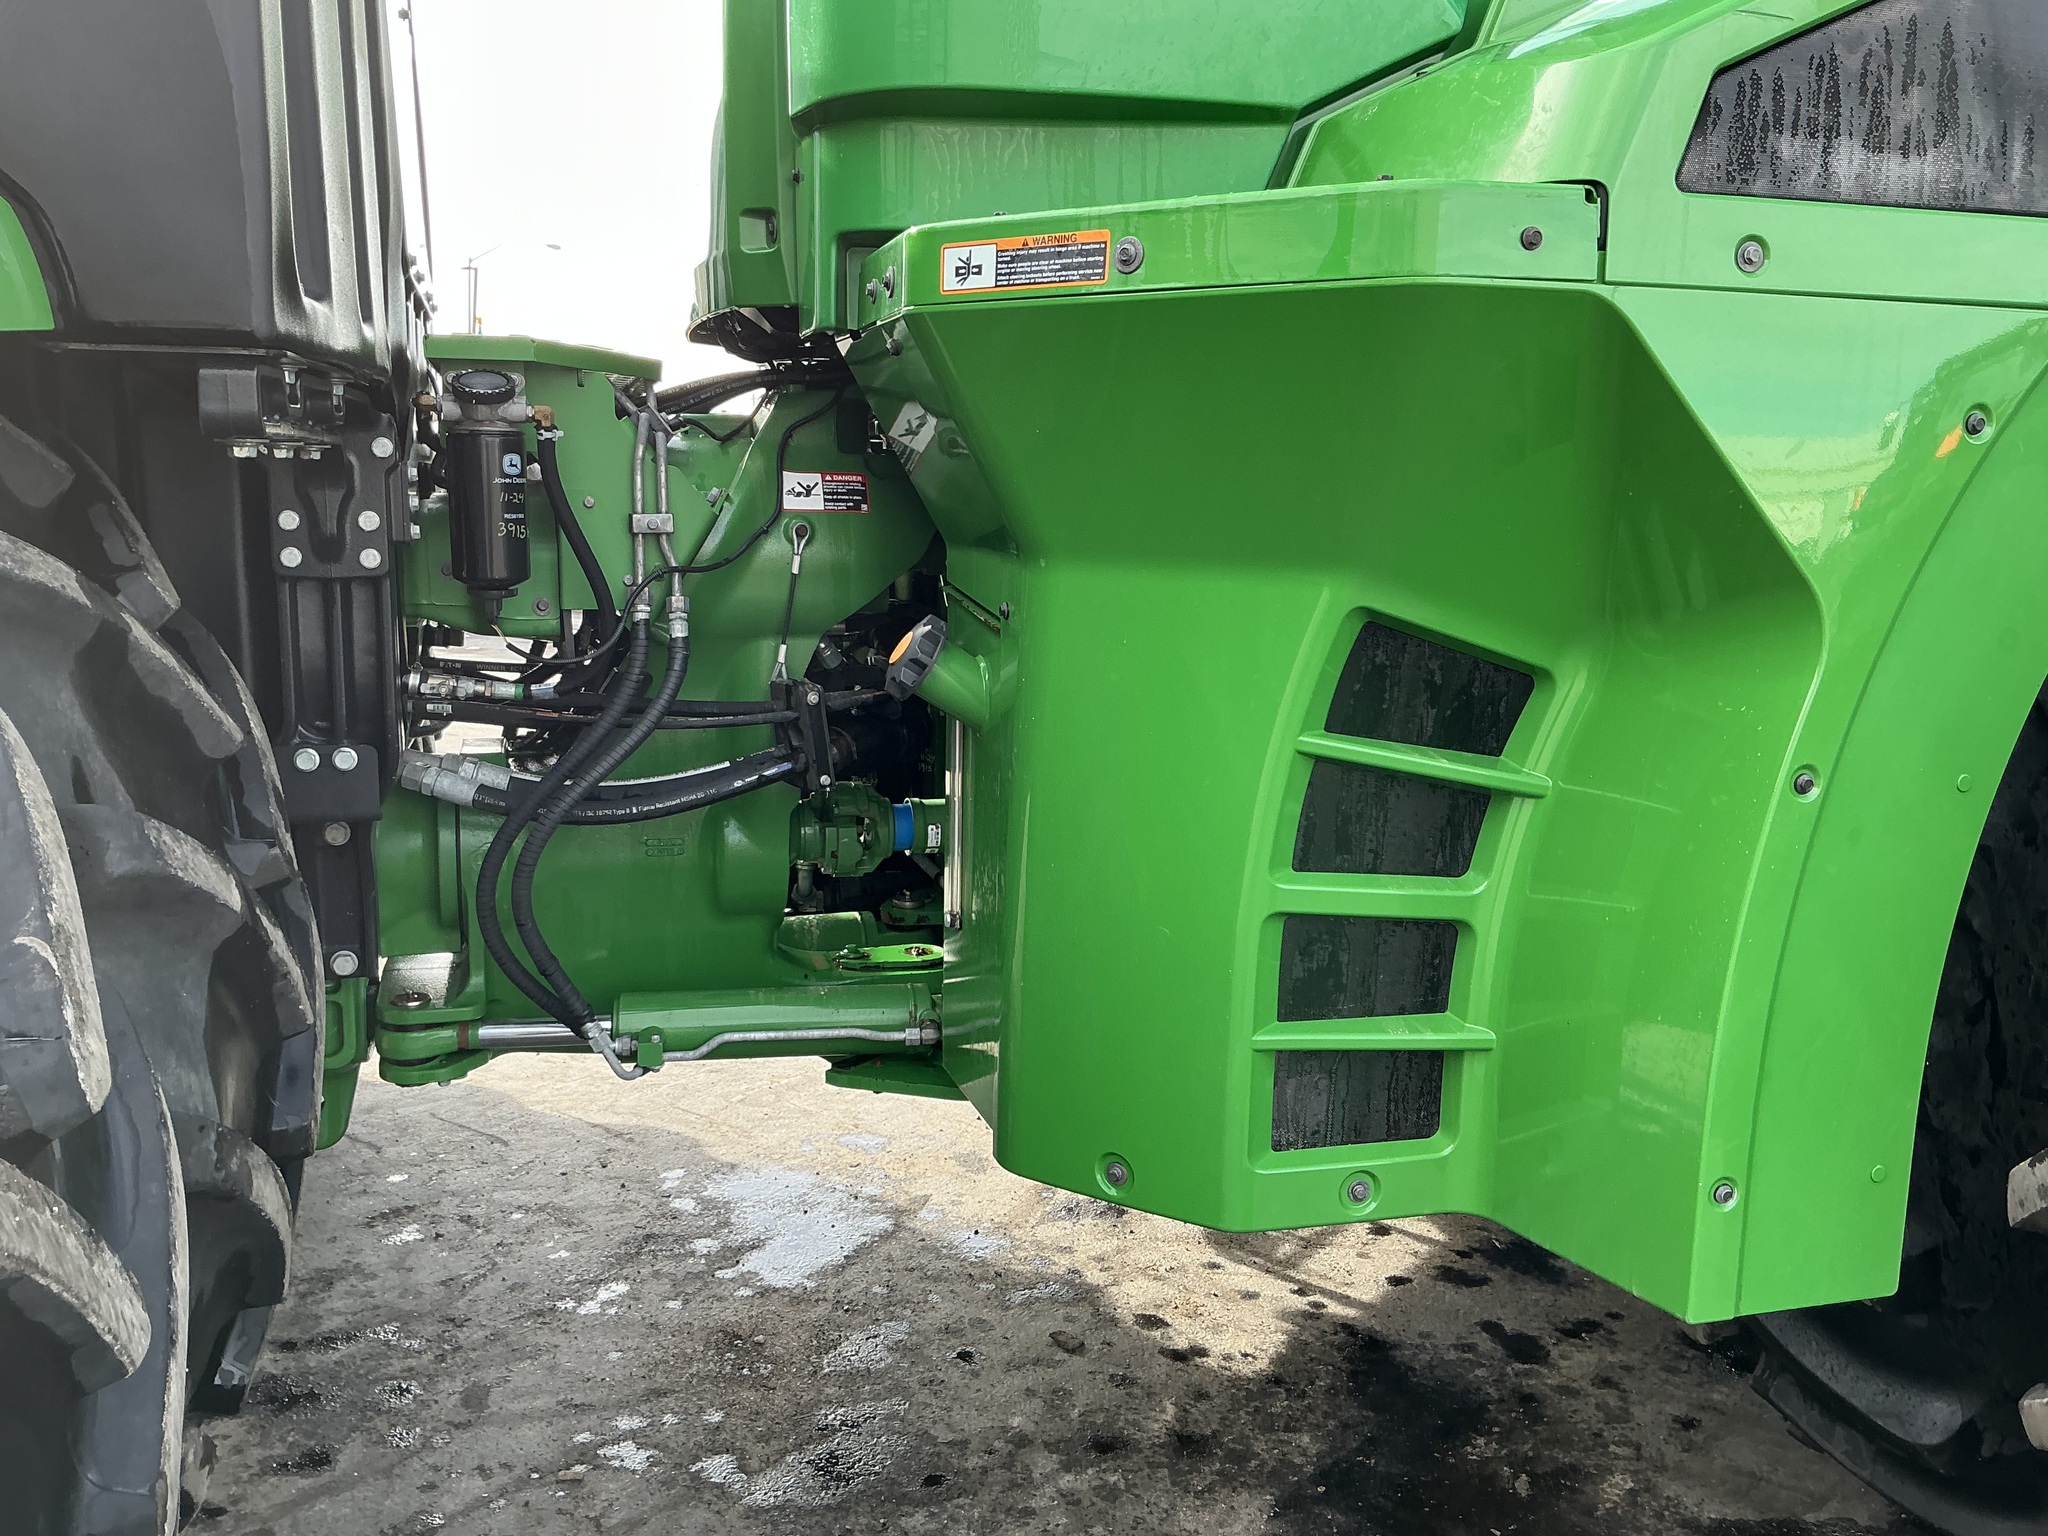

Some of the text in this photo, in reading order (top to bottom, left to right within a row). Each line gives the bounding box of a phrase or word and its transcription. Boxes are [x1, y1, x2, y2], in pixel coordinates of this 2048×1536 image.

[1033, 233, 1077, 246] WARNING
[500, 491, 525, 504] 11-24
[497, 521, 526, 539] 3915
[656, 798, 681, 809] Resistant
